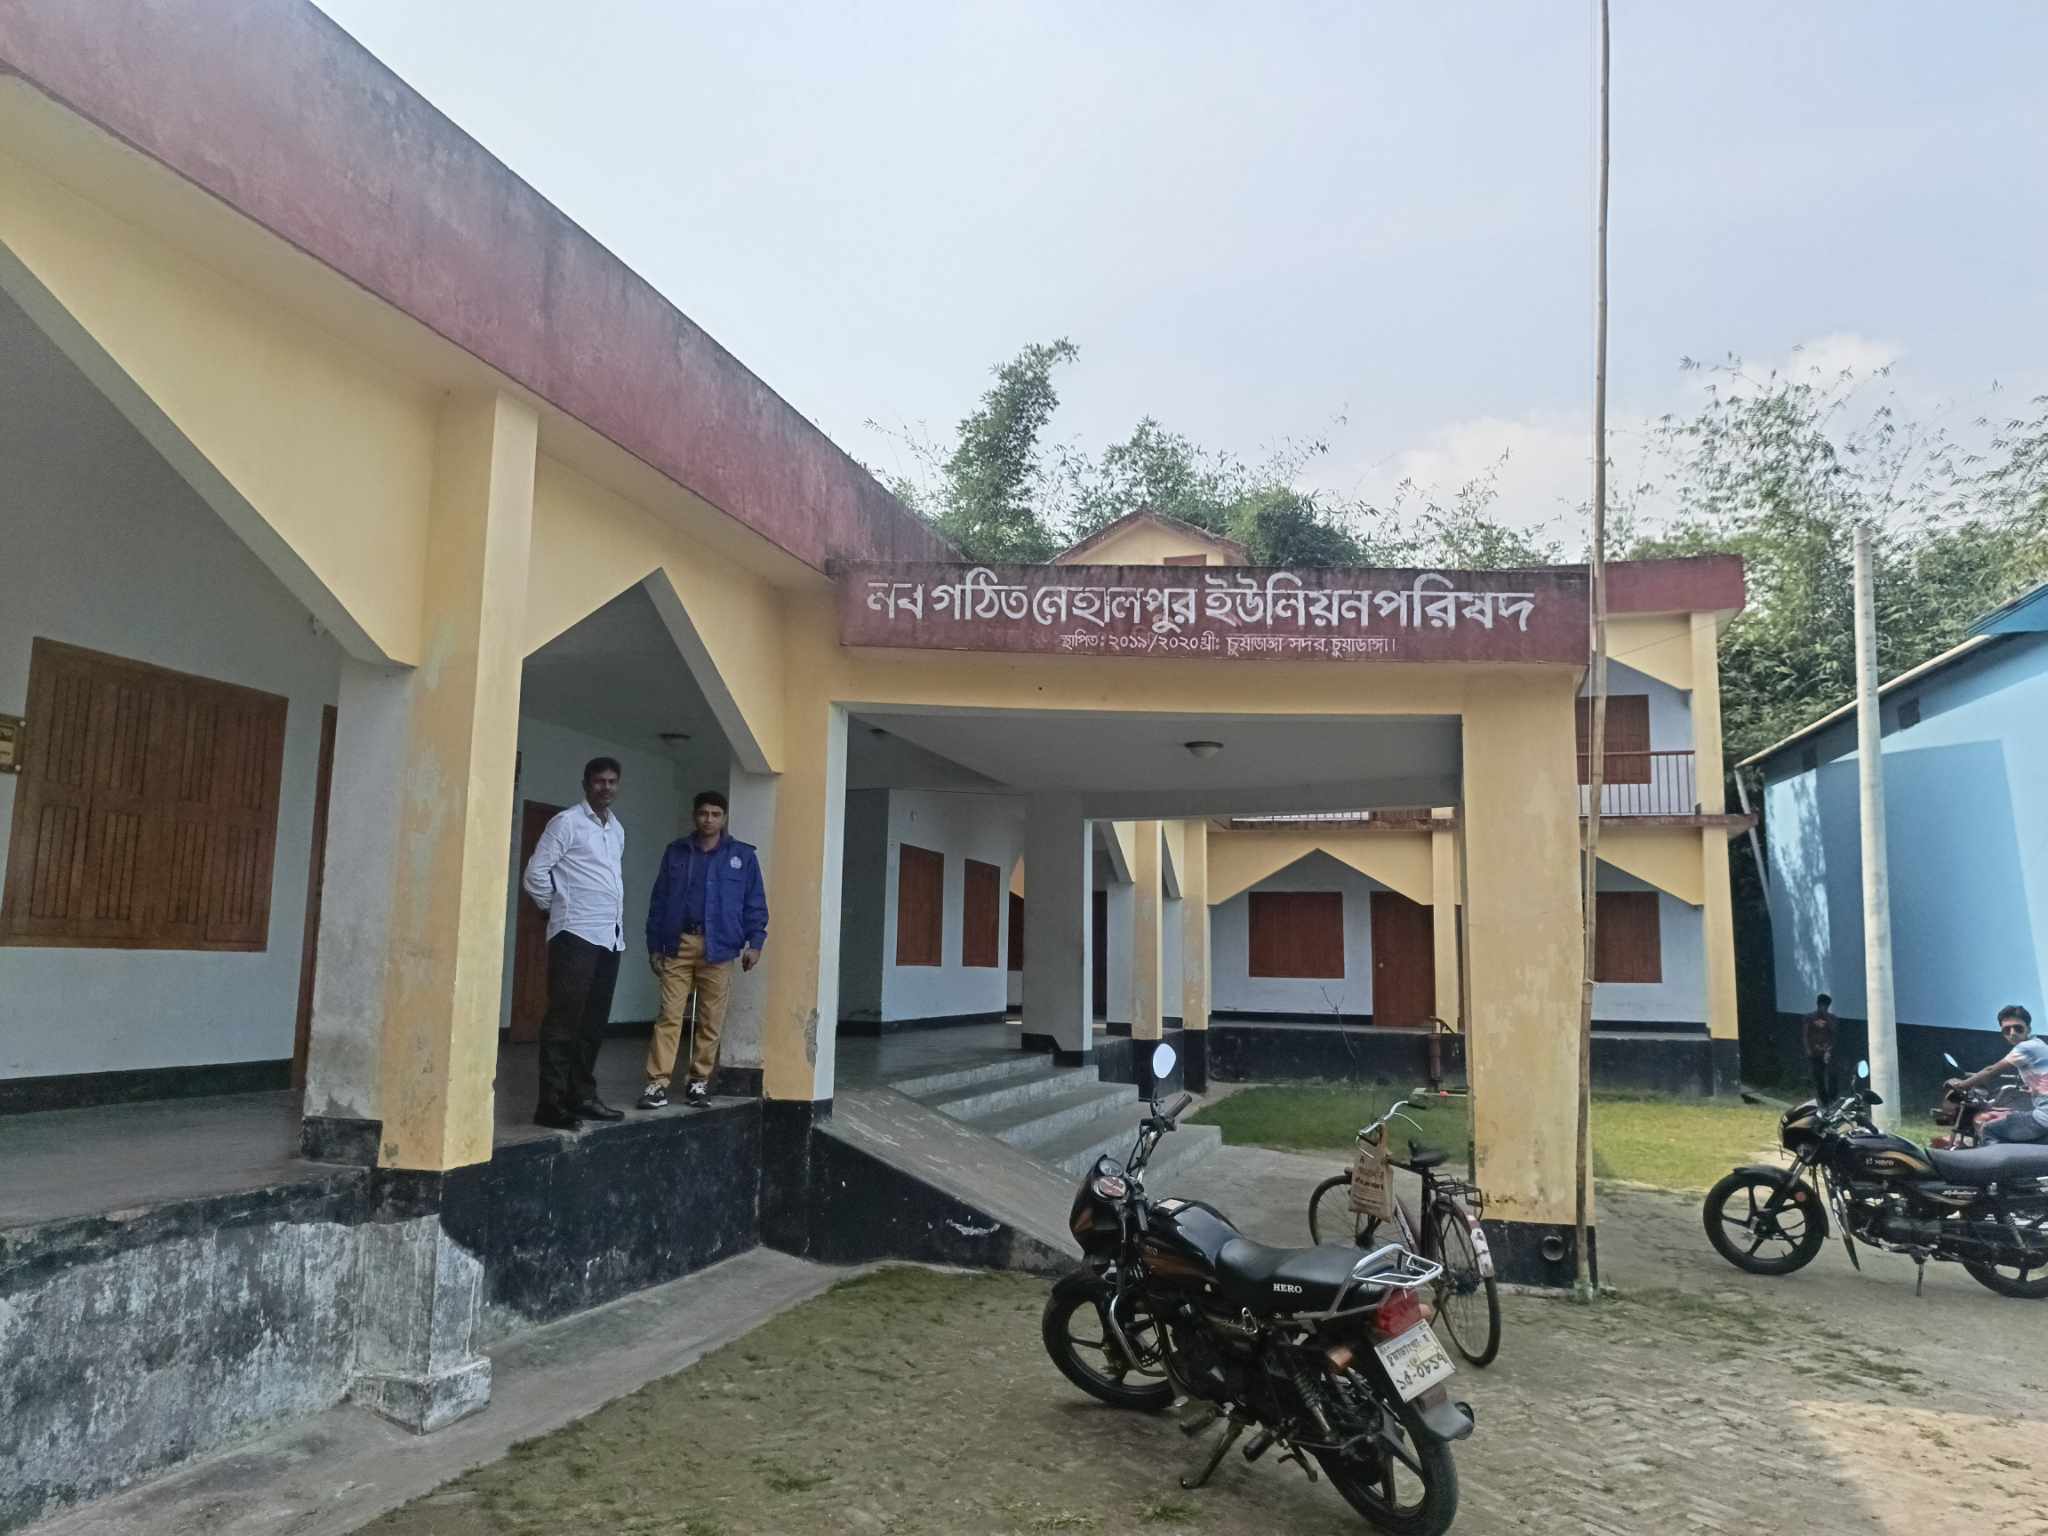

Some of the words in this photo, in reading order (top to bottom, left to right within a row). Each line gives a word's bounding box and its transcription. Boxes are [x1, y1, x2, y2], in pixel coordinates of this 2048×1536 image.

[867, 582, 924, 619] নব
[931, 566, 1028, 620] গঠিত
[1032, 586, 1198, 633] নেহালপুর
[1273, 1283, 1303, 1294] HERO
